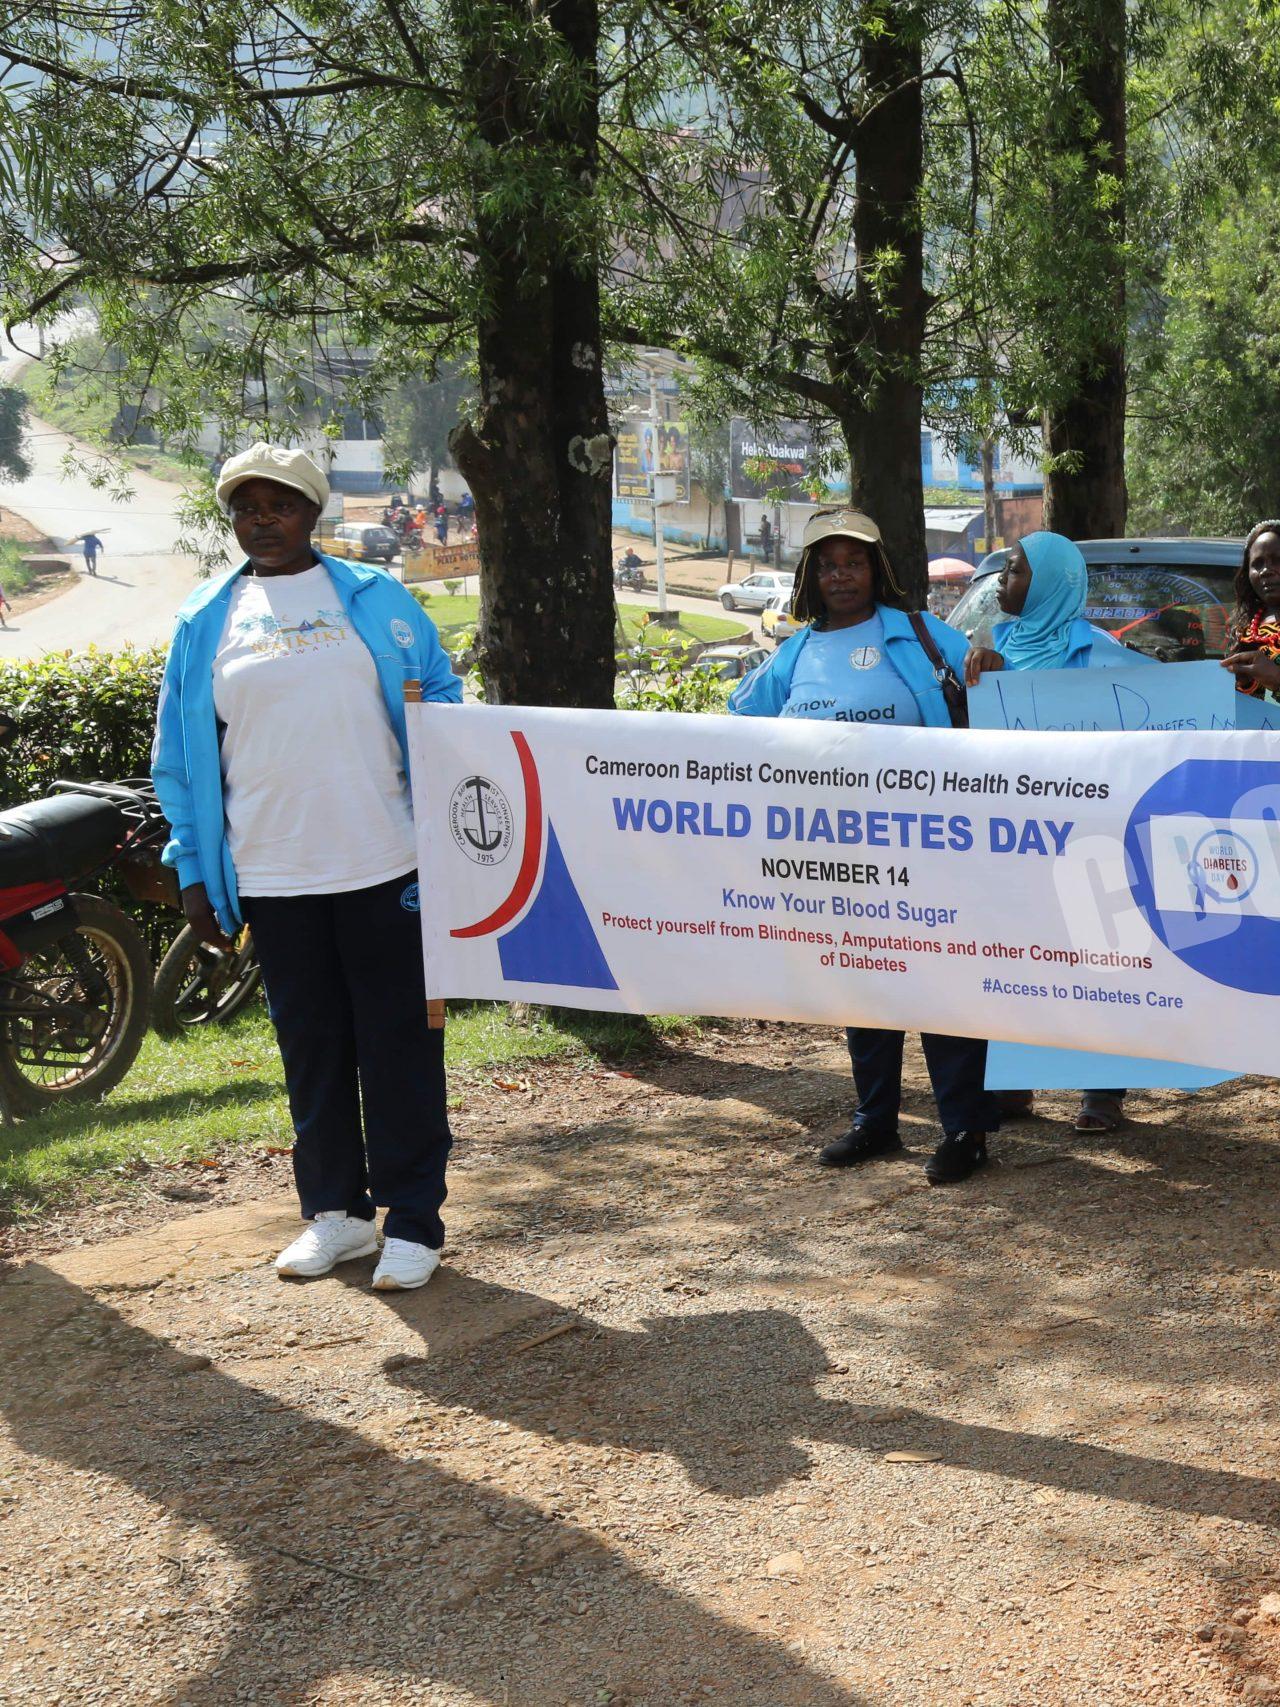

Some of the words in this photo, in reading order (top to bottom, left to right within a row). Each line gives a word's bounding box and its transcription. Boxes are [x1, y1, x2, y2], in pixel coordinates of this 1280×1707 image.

[835, 703, 896, 722] Blood
[586, 755, 679, 778] Cameroon
[687, 760, 752, 785] Baptist
[759, 763, 868, 787] Convention
[876, 769, 935, 796] (CBC)
[943, 771, 1008, 794] Health
[1016, 775, 1109, 799] Services
[452, 801, 467, 846] CAMEROON
[499, 798, 512, 849] CONVENTION
[613, 798, 751, 837] WORLD
[767, 806, 973, 851] DIABETES
[989, 818, 1075, 856] DAY
[477, 853, 495, 863] 1975
[762, 858, 880, 885] NOVEMBER
[887, 866, 909, 886] 14
[1203, 857, 1248, 872] DIABETES
[723, 888, 775, 910] Know
[781, 893, 825, 913] Your
[832, 897, 889, 919] Blood
[897, 901, 957, 927] Sugar
[602, 912, 652, 930] Protect
[656, 919, 716, 938] yourself
[720, 922, 754, 938] from
[759, 925, 837, 947] Blindness,
[842, 931, 941, 953] Amputations
[947, 941, 976, 955] and
[982, 943, 1024, 959] other
[1030, 945, 1152, 969] Complications
[821, 952, 835, 966] of
[840, 953, 907, 972] Diabetes
[983, 978, 1047, 997] #Access
[1053, 985, 1067, 998] to
[1073, 985, 1140, 1005] Diabetes
[1146, 992, 1183, 1008] Care
